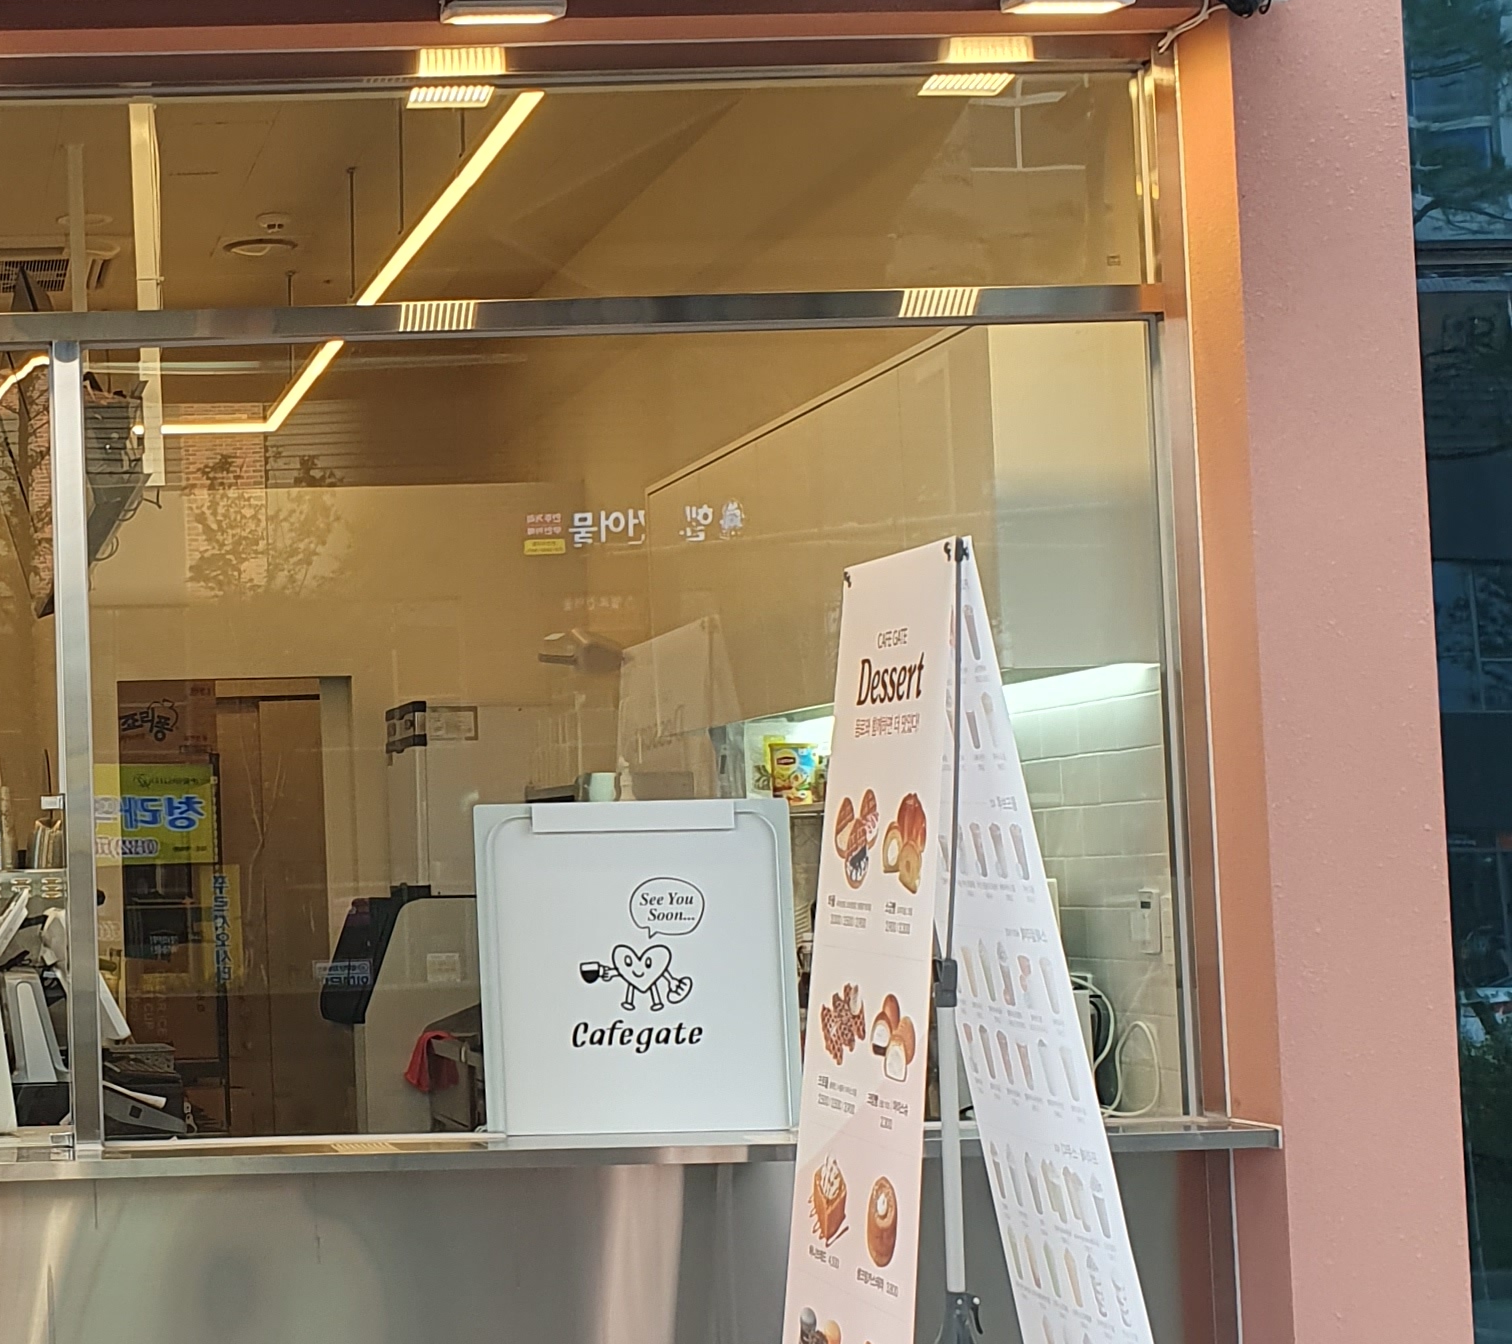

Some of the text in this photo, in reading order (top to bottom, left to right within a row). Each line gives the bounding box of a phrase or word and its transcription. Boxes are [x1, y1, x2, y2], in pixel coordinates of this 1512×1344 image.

[855, 651, 925, 707] Dessert
[639, 890, 695, 907] See You
[647, 907, 696, 922] Soon...
[571, 1019, 704, 1054] Cafegate
